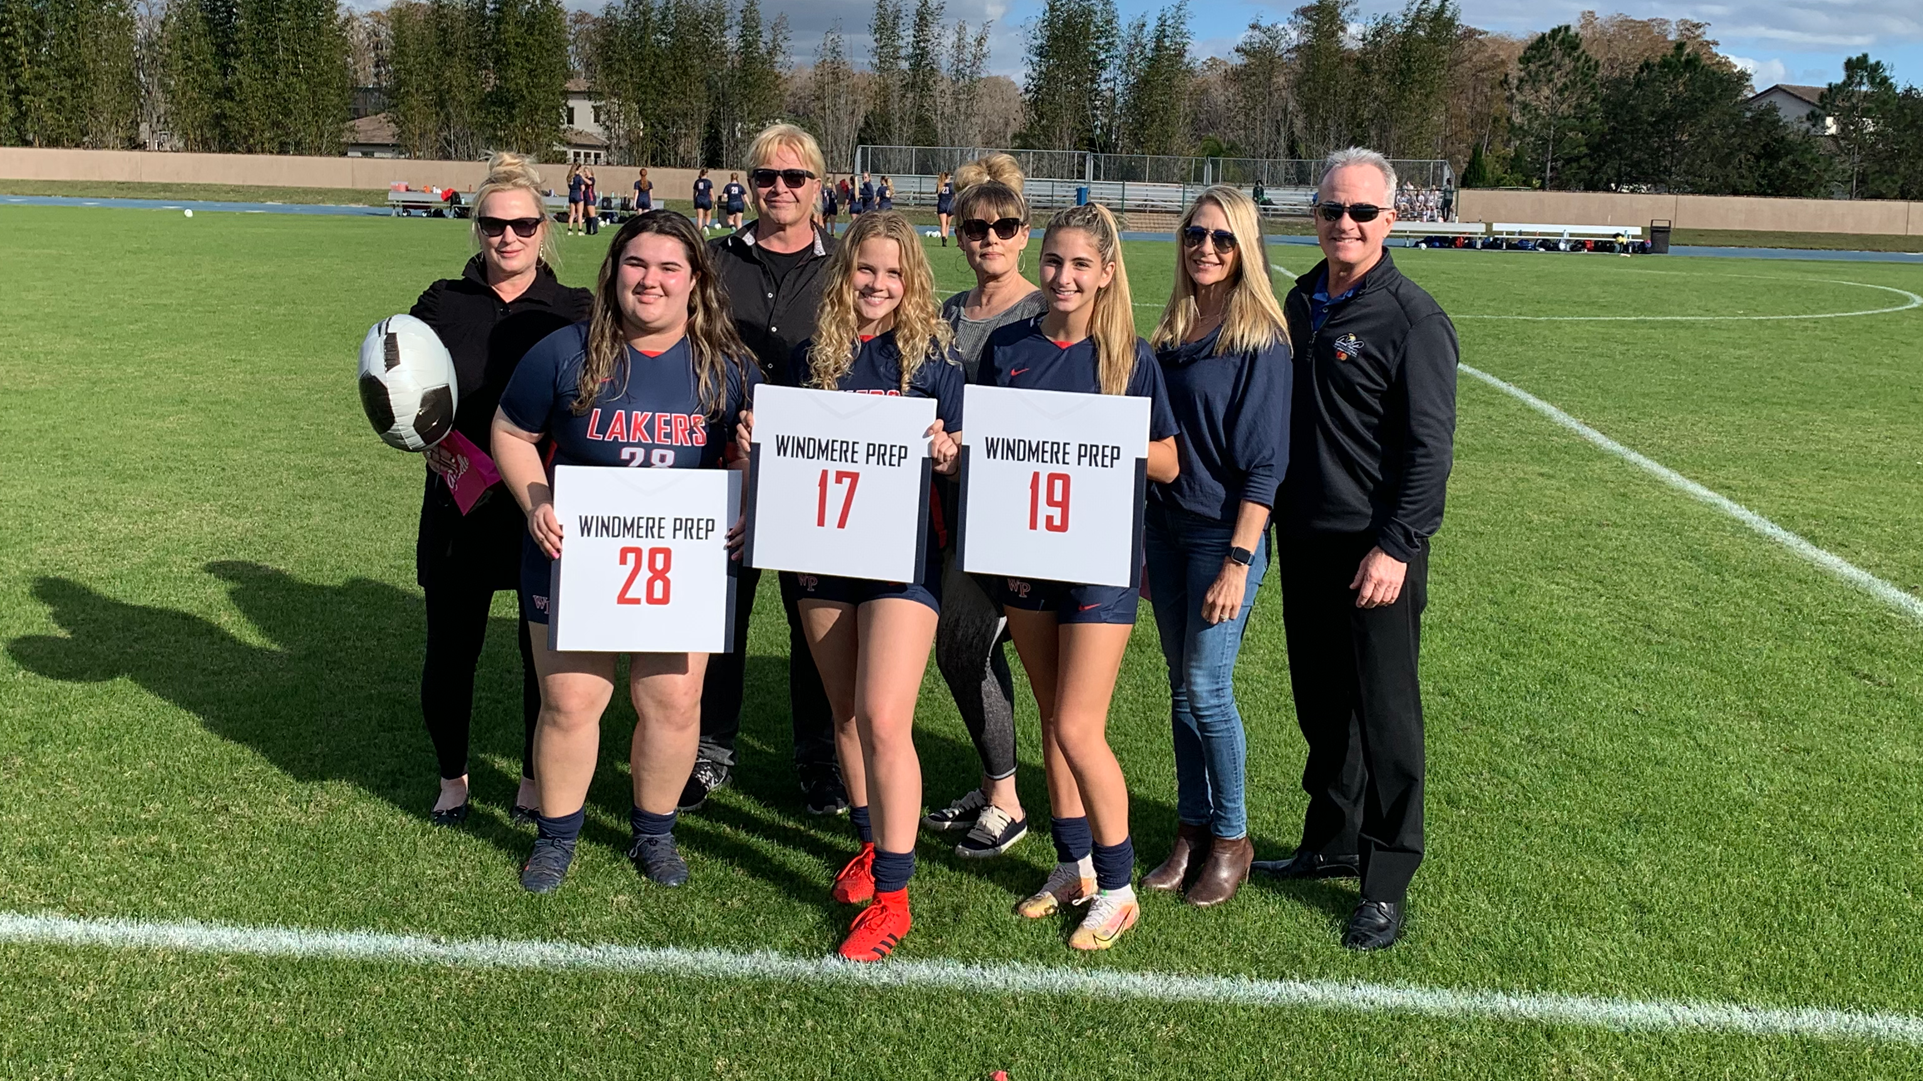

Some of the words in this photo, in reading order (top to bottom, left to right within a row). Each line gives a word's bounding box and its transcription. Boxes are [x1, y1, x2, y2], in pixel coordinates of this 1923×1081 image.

[587, 408, 707, 447] LAKERS
[775, 434, 860, 464] WINDMERE
[866, 443, 908, 467] PREP
[985, 436, 1071, 465] WINDMERE
[1077, 443, 1121, 469] PREP
[817, 469, 860, 529] 17
[1028, 471, 1071, 533] 19
[578, 515, 666, 539] WINDMERE
[673, 518, 715, 540] PREP
[616, 546, 672, 605] 28
[1007, 578, 1031, 598] WP
